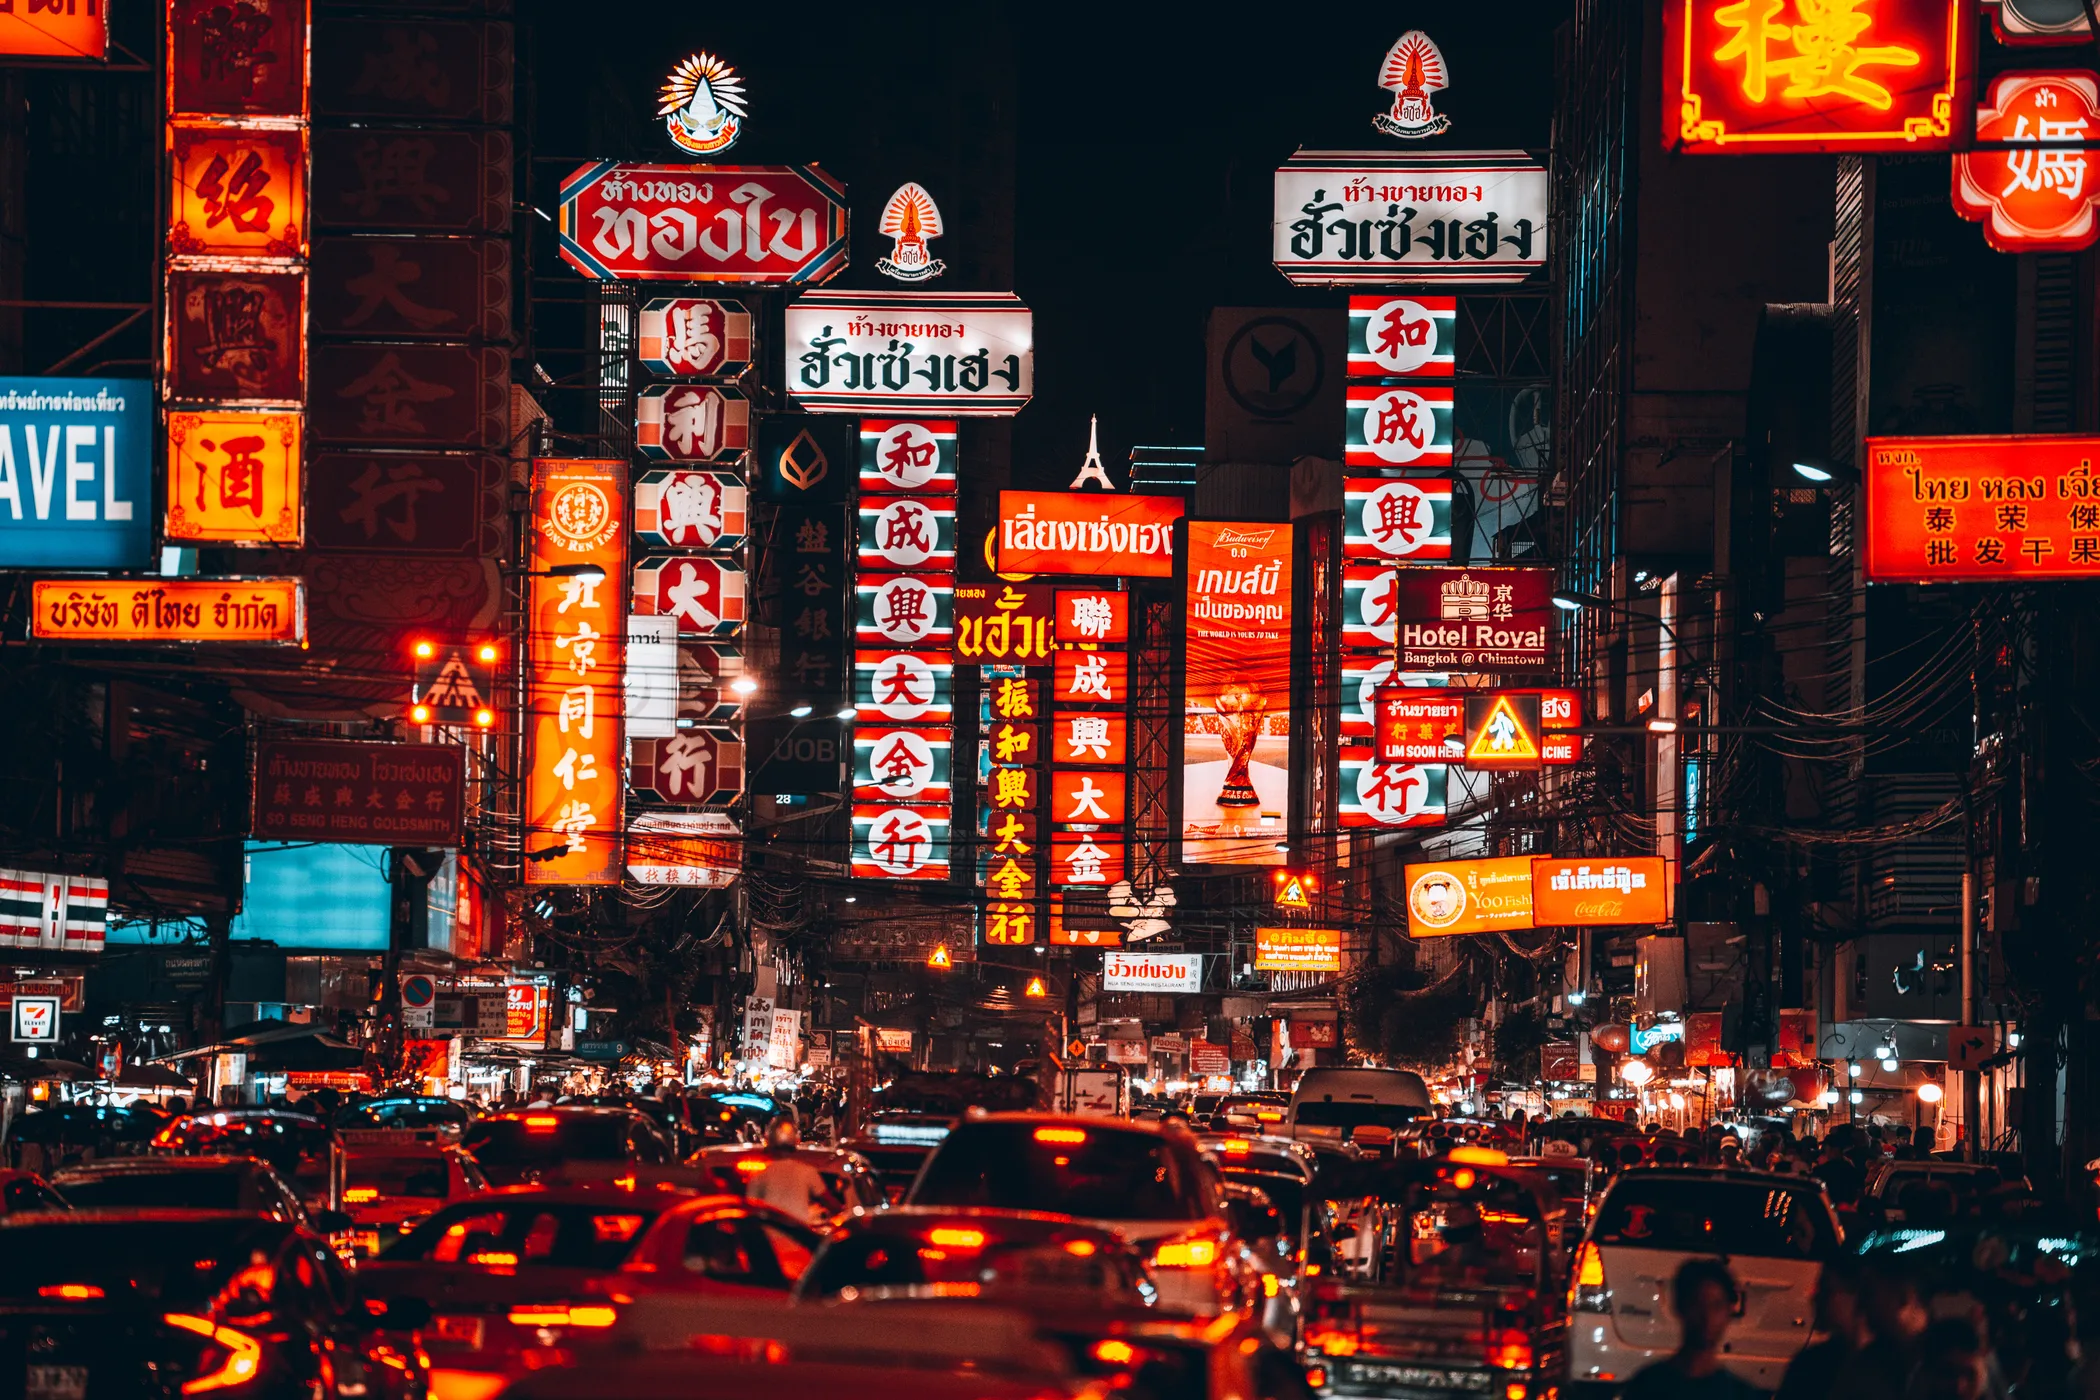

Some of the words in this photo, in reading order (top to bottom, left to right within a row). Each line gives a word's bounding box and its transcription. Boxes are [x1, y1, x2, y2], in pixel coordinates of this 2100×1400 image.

[2002, 114, 2088, 200] 媽
[600, 171, 714, 203] ห้างทอง
[1342, 176, 1483, 203] ห้างขายทอง
[591, 182, 818, 263] ทองใบ
[1289, 189, 1533, 261] ฮั่วเซ่งเฮง
[846, 314, 965, 339] ห้างขายทอง
[798, 324, 1020, 393] ฮั่วเซ่งเฮง
[0, 424, 133, 521] AVEL
[1904, 467, 1970, 501] ไทย
[1980, 477, 2046, 501] หลง
[541, 519, 566, 547] TONG
[567, 539, 595, 552] REN
[593, 520, 620, 546] TANG
[1219, 531, 1270, 544] Budweiser
[1231, 547, 1248, 558] 0.0
[1363, 307, 1431, 814] 和成興行
[1196, 559, 1283, 595] เกมส์นี้
[50, 593, 119, 629] บริษัท
[130, 588, 201, 629] ดีไทย
[213, 591, 278, 629] จำกัด
[1194, 595, 1283, 625] เป็นของคุณ
[1492, 584, 1513, 622] 京华
[957, 586, 1054, 659] นฮั้วเ
[1237, 631, 1256, 639] YOURS
[1403, 624, 1468, 647] Hotel
[1476, 626, 1545, 649] Royal
[873, 430, 937, 868] 和成興大金行
[1403, 652, 1458, 666] Bangkok
[1461, 652, 1475, 666] @
[1478, 653, 1545, 665] Chinatown
[552, 577, 601, 853] 北京同仁堂
[1387, 700, 1458, 718] ร้านขายยา
[774, 739, 836, 762] UOB
[1385, 745, 1404, 758] LIM
[1406, 745, 1436, 758] SOON
[1065, 594, 1113, 943] 聯成興大金
[775, 794, 791, 804] 28
[989, 677, 1033, 944] 振和興大金行
[265, 812, 285, 825] SO
[290, 813, 326, 828] SENG
[330, 815, 368, 829] HENG
[373, 816, 450, 832] GOLDSMITH
